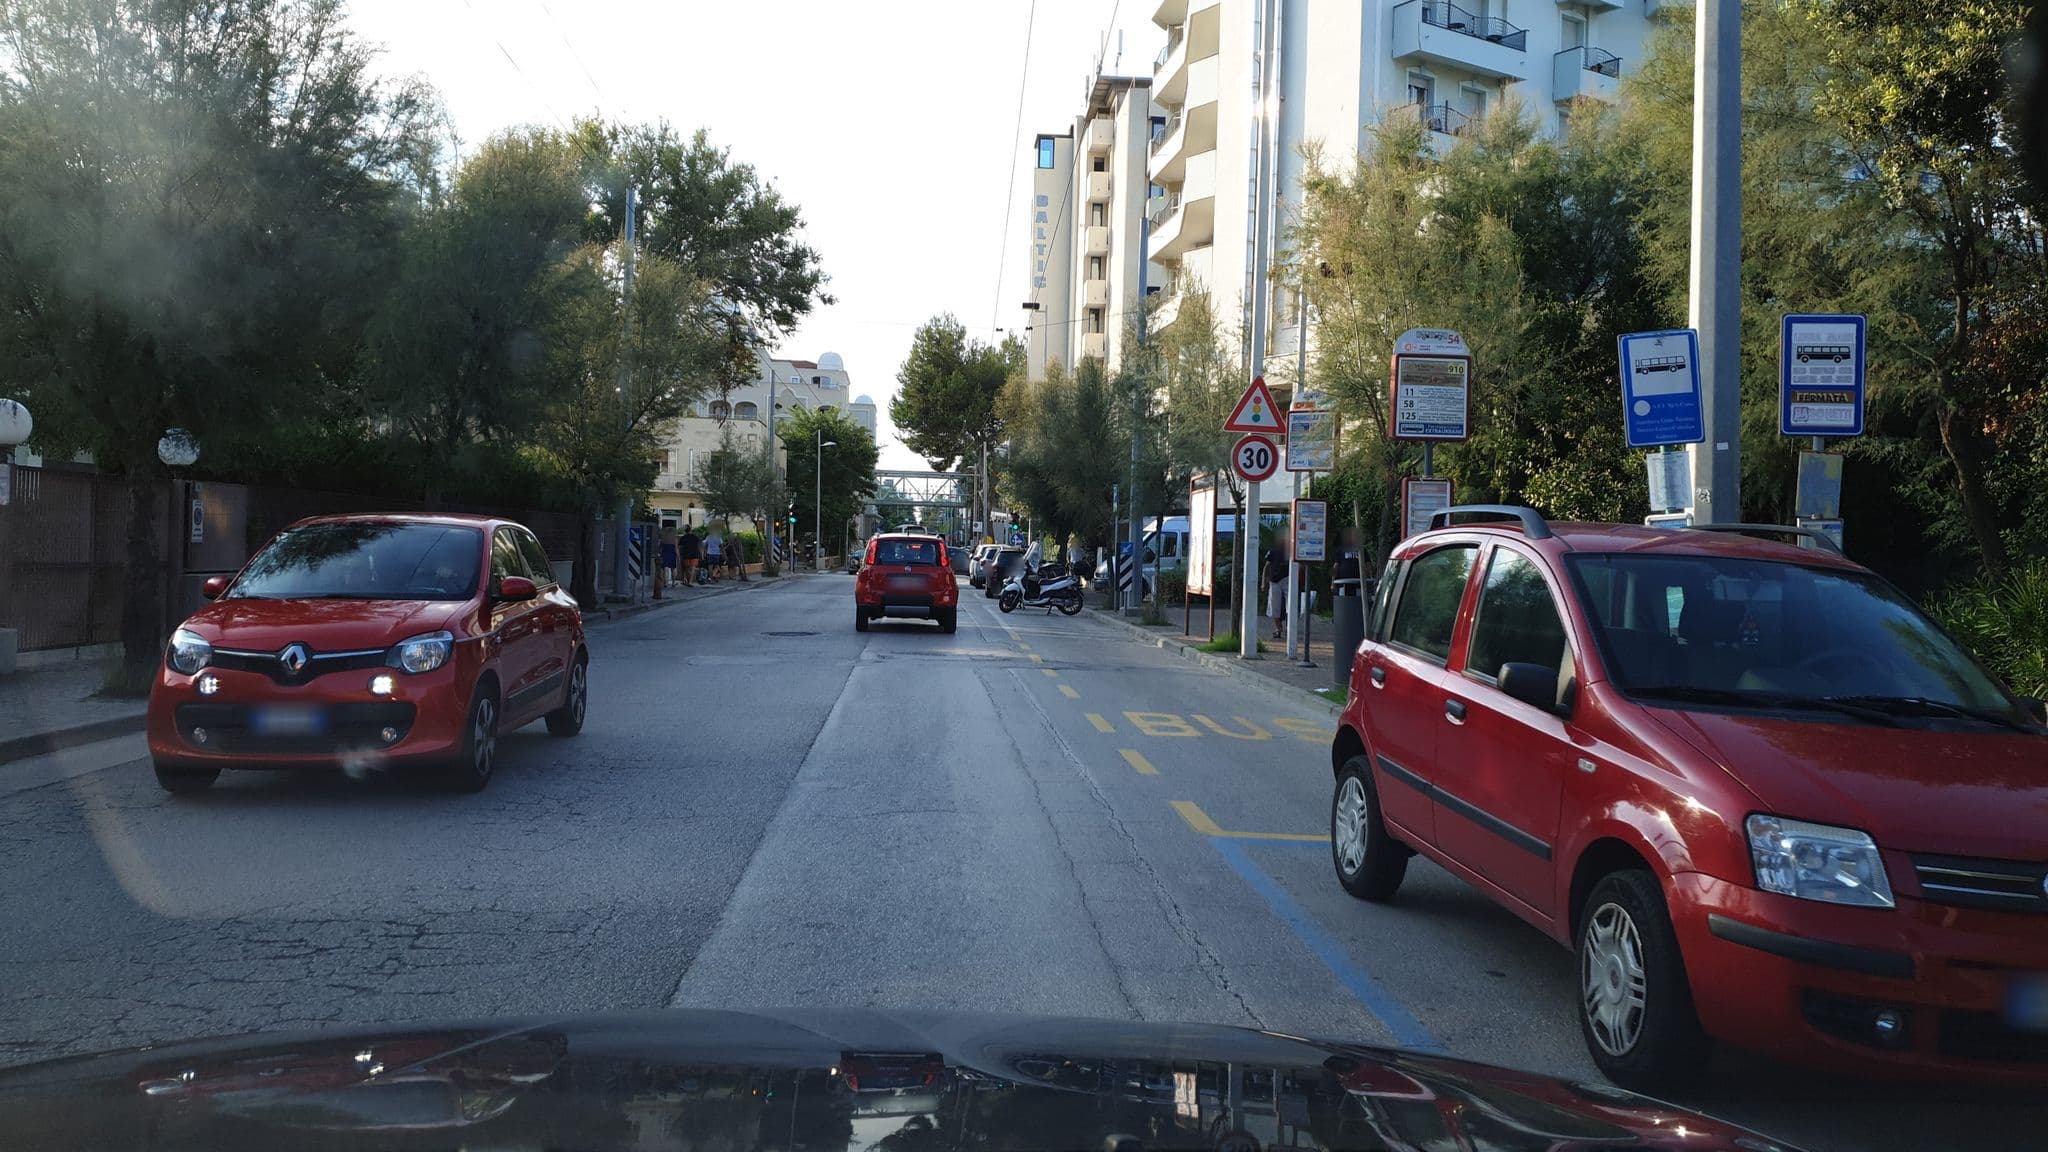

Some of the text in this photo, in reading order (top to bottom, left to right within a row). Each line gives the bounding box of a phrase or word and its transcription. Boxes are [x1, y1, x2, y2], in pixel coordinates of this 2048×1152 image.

[1034, 195, 1048, 288] BALTIC
[1447, 335, 1460, 345] 54
[1448, 365, 1464, 374] 910
[1405, 388, 1414, 396] 11
[1796, 391, 1849, 402] FERMATA
[1403, 400, 1414, 408] 58
[1401, 412, 1416, 420] 125
[1243, 448, 1269, 469] 30
[1122, 711, 1336, 743] BUS
